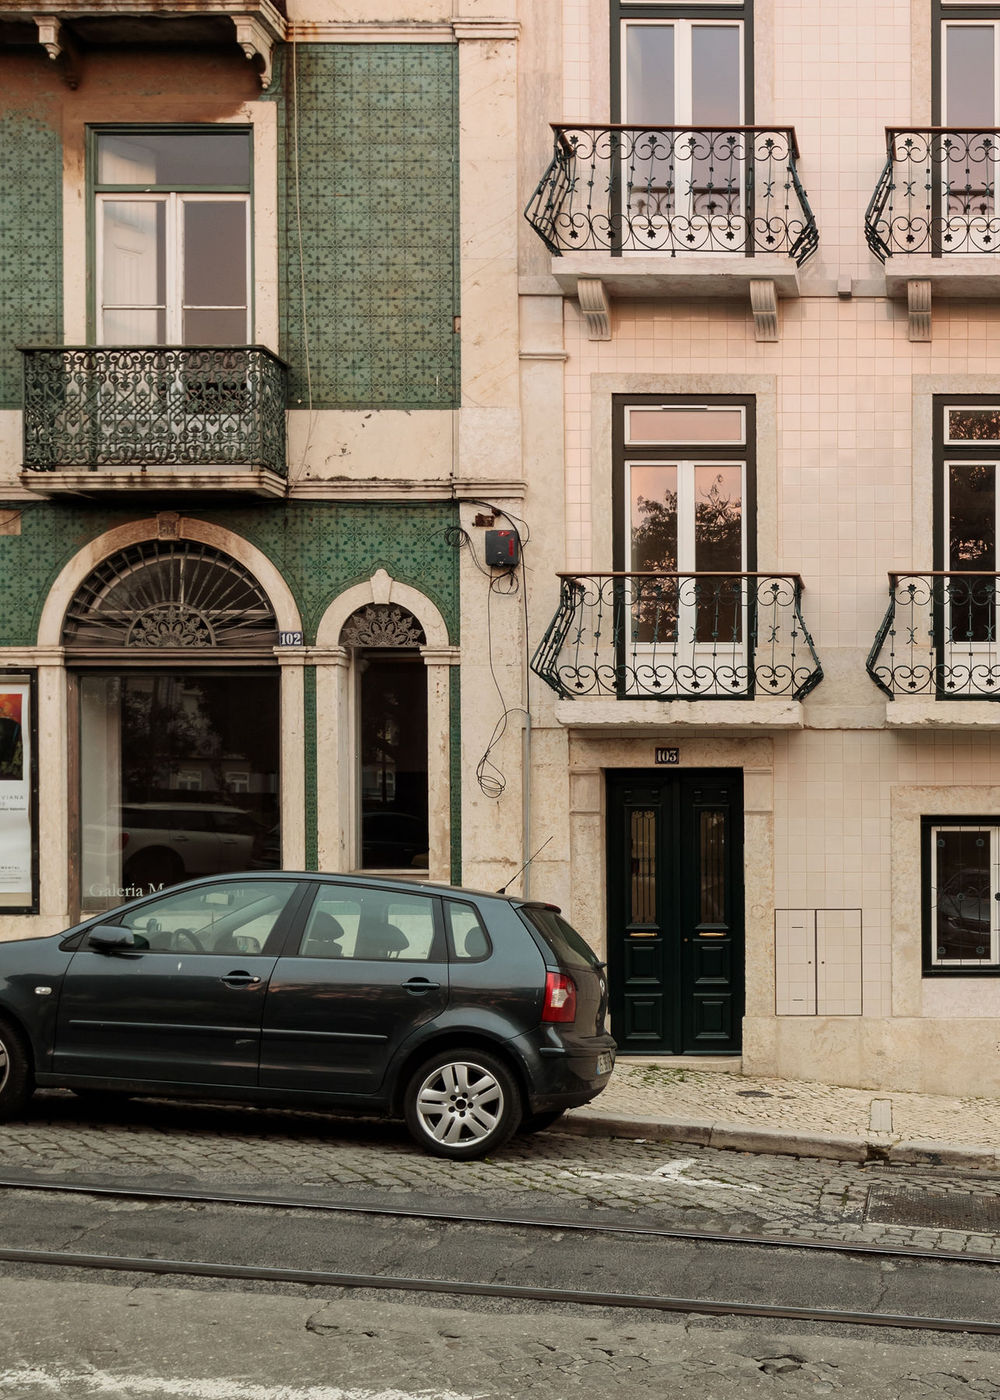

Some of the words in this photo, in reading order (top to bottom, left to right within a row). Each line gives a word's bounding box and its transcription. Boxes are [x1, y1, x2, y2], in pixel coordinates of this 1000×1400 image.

[281, 633, 301, 645] 102
[657, 750, 677, 762] 103
[89, 882, 143, 897] Galeria
